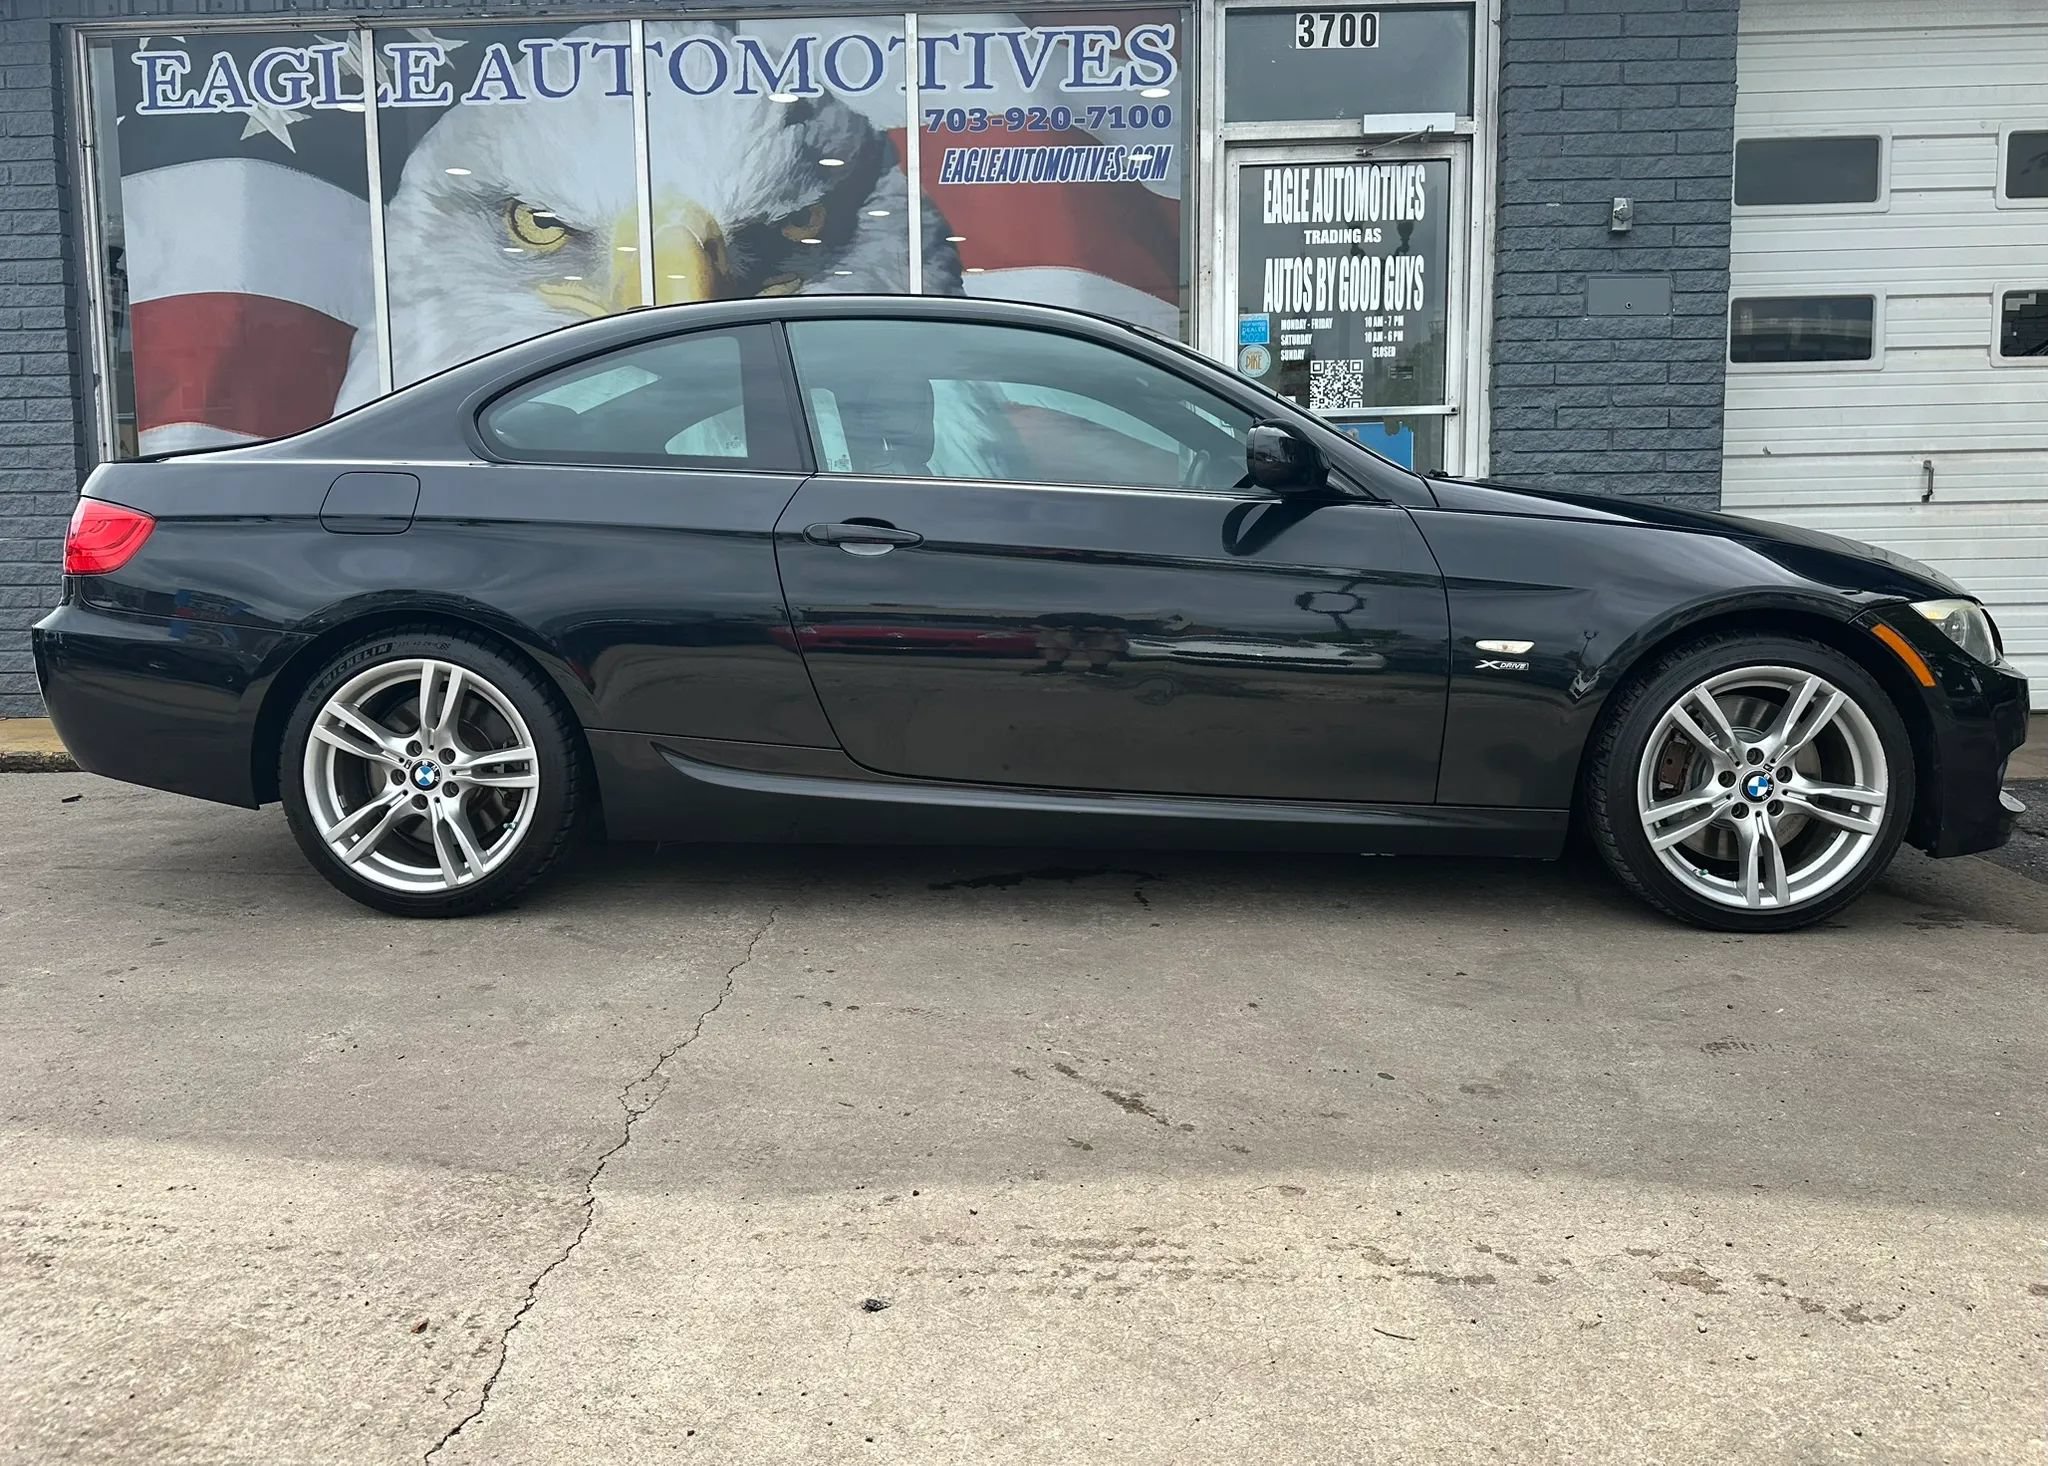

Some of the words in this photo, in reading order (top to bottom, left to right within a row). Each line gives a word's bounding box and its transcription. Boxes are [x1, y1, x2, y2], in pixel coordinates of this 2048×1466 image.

[1298, 13, 1377, 47] 3700
[136, 41, 451, 112] EAGLE
[464, 27, 1176, 104] AUTOMOTIVES
[925, 106, 1172, 132] 703-920-7100
[941, 146, 1173, 184] EAGLEAUTOMOTIVES.COM
[1263, 167, 1310, 224] EAGLE
[1311, 164, 1426, 223] AUTOMOTIVES
[1304, 229, 1362, 245] TRADING
[1363, 228, 1382, 243] AS
[1262, 256, 1313, 313] AUTOS
[1316, 256, 1337, 312] BY
[1339, 255, 1381, 312] GOOD
[1384, 254, 1425, 311] GUYS
[1281, 319, 1307, 331] MONDAY
[1311, 318, 1334, 330] FRIDAY
[1364, 316, 1373, 328] 10
[1373, 315, 1383, 327] AM
[1388, 315, 1392, 327] 7
[1393, 315, 1404, 327] PM
[1281, 334, 1312, 346] SATURDAY
[1364, 331, 1373, 343] 10
[1373, 331, 1383, 342] AM
[1387, 330, 1393, 342] 6
[1393, 330, 1404, 342] PM
[1281, 349, 1305, 361] SUNDAY
[1372, 346, 1396, 358] CLOSED
[320, 643, 392, 689] MICHELIN
